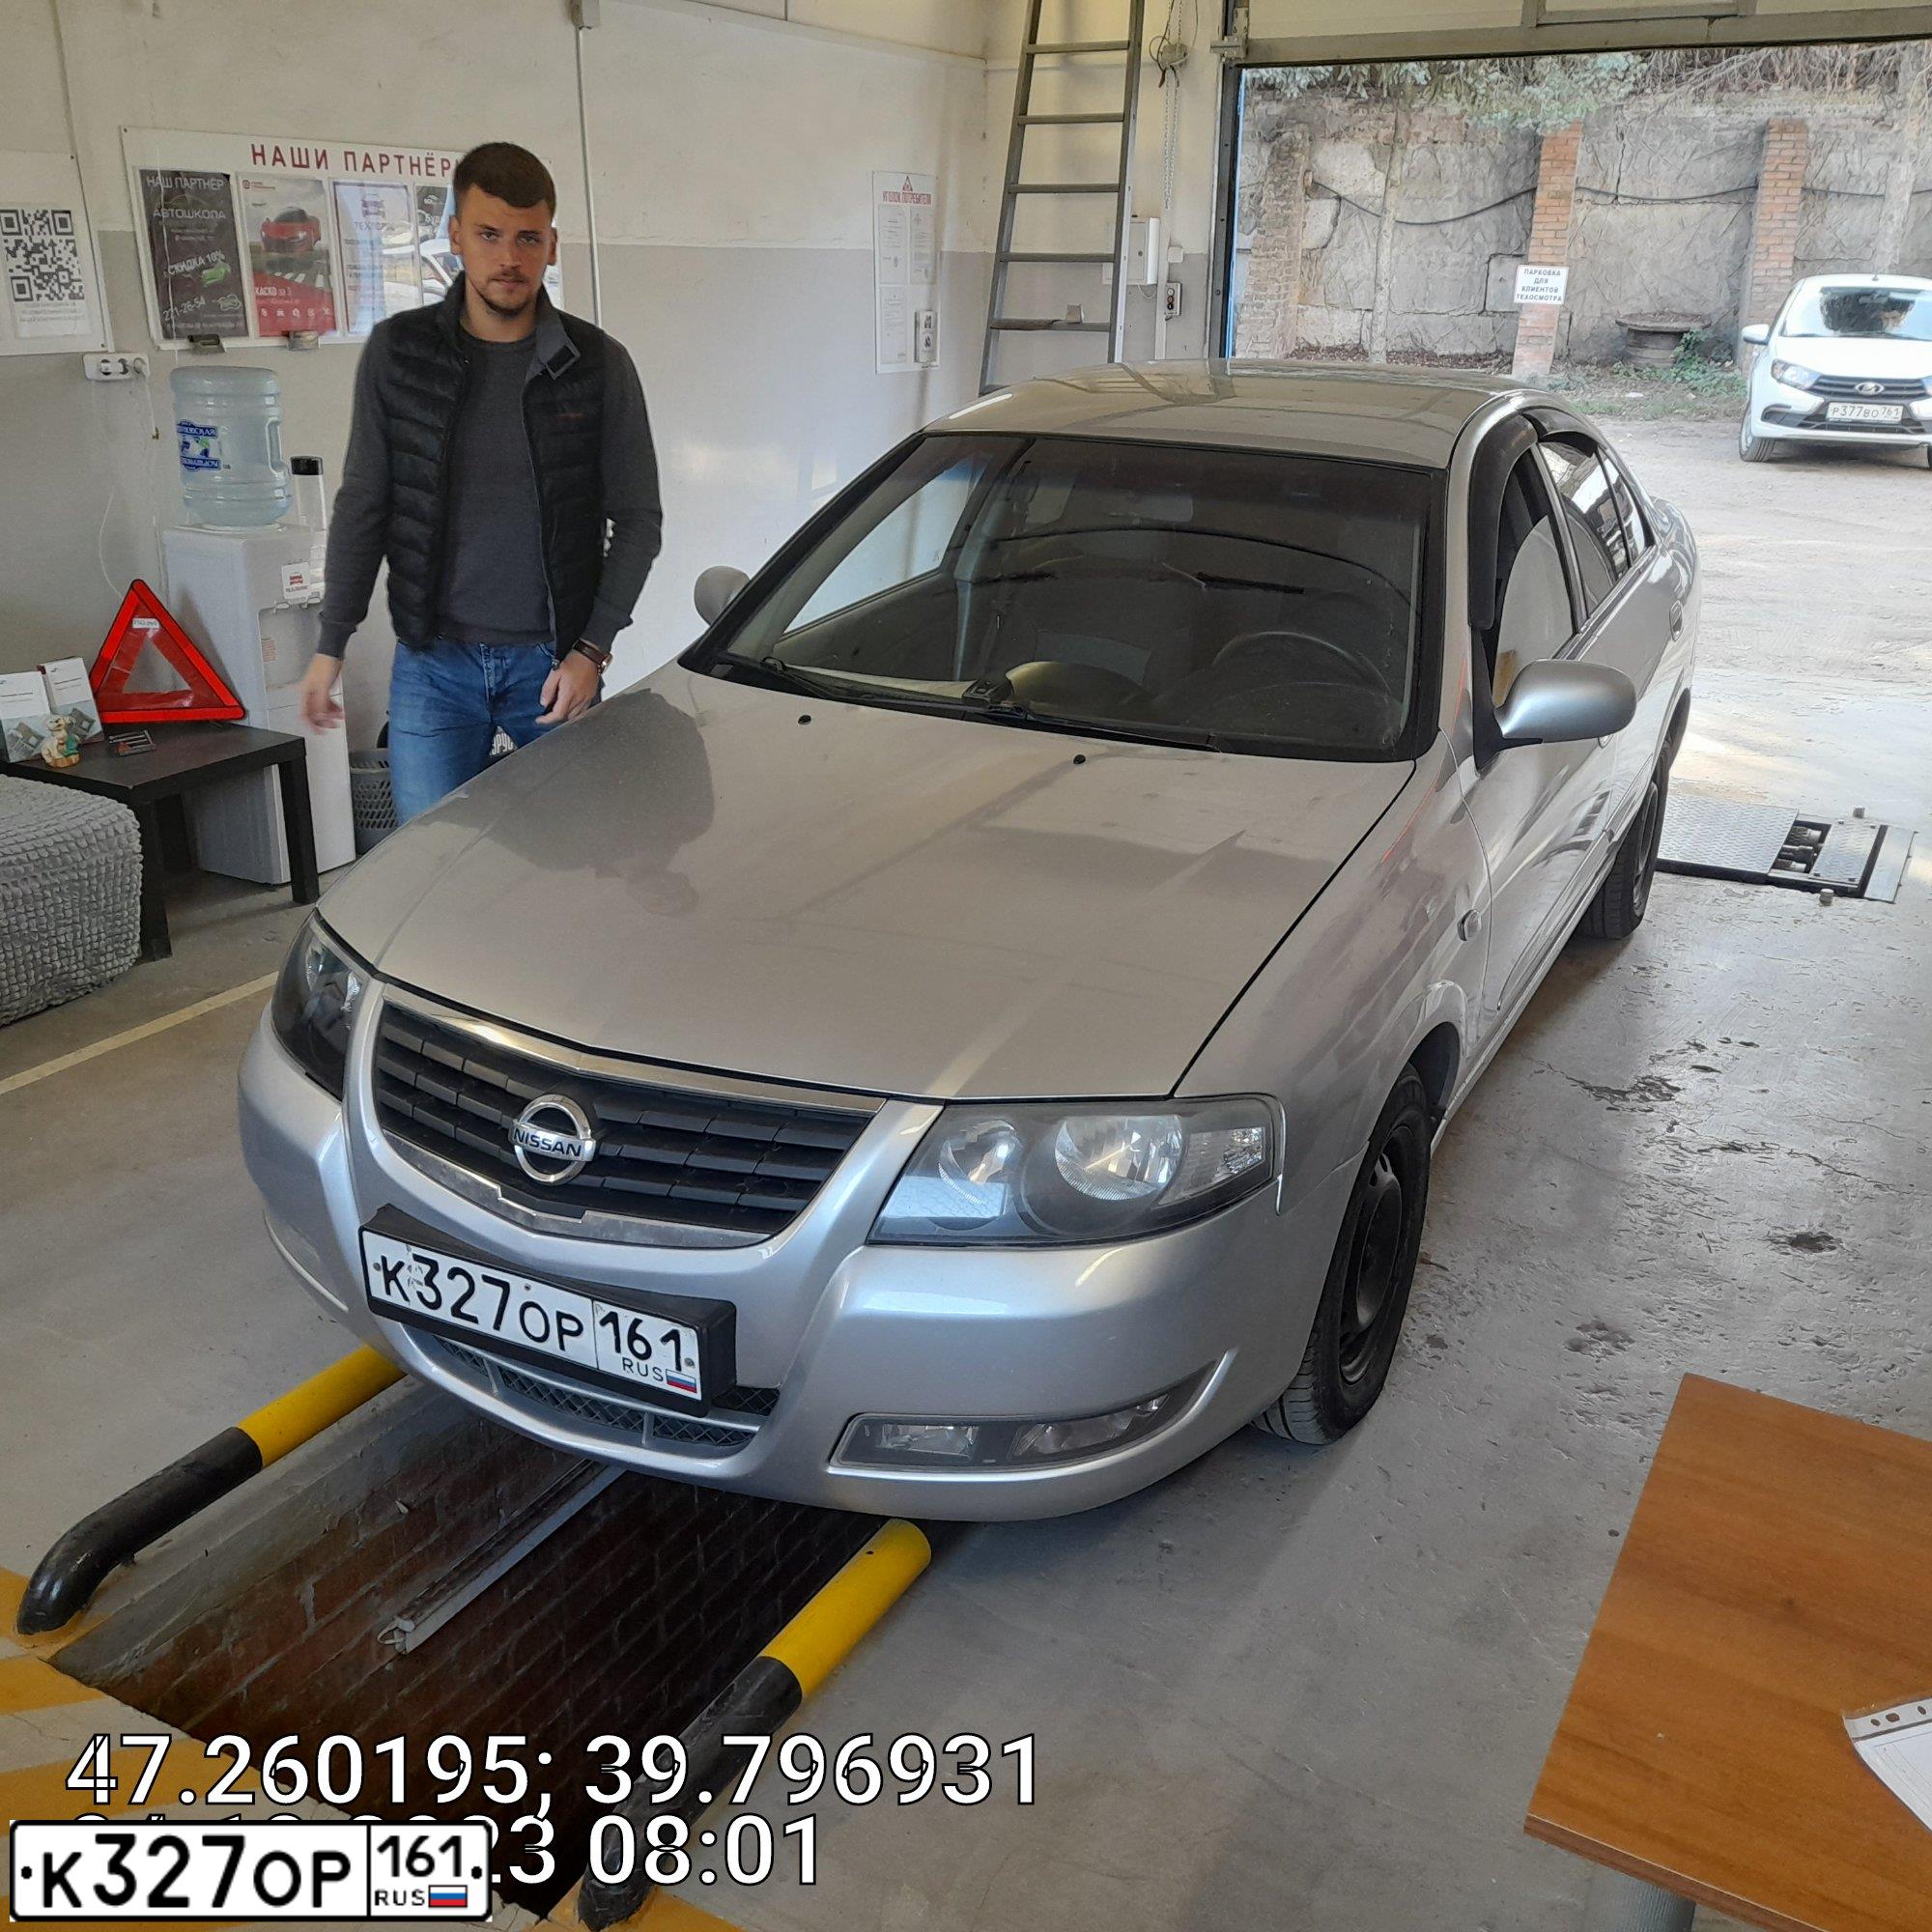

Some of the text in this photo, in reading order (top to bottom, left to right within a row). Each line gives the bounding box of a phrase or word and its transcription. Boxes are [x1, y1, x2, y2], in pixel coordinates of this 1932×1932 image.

[250, 143, 460, 178] НАШИ ПАРТНЁР
[146, 175, 173, 189] НАШ
[153, 208, 227, 220] АВТОШКОЛА
[167, 256, 206, 275] СКИДКА
[1523, 268, 1561, 276] ПАРКОВКА
[1516, 293, 1562, 301] ТЕХОСМОТРА
[1520, 285, 1559, 294] КЛИЕНТОВ
[513, 1127, 582, 1157] NISSAN
[380, 1252, 682, 1372] К327ОР 161
[621, 1356, 665, 1382] RUS
